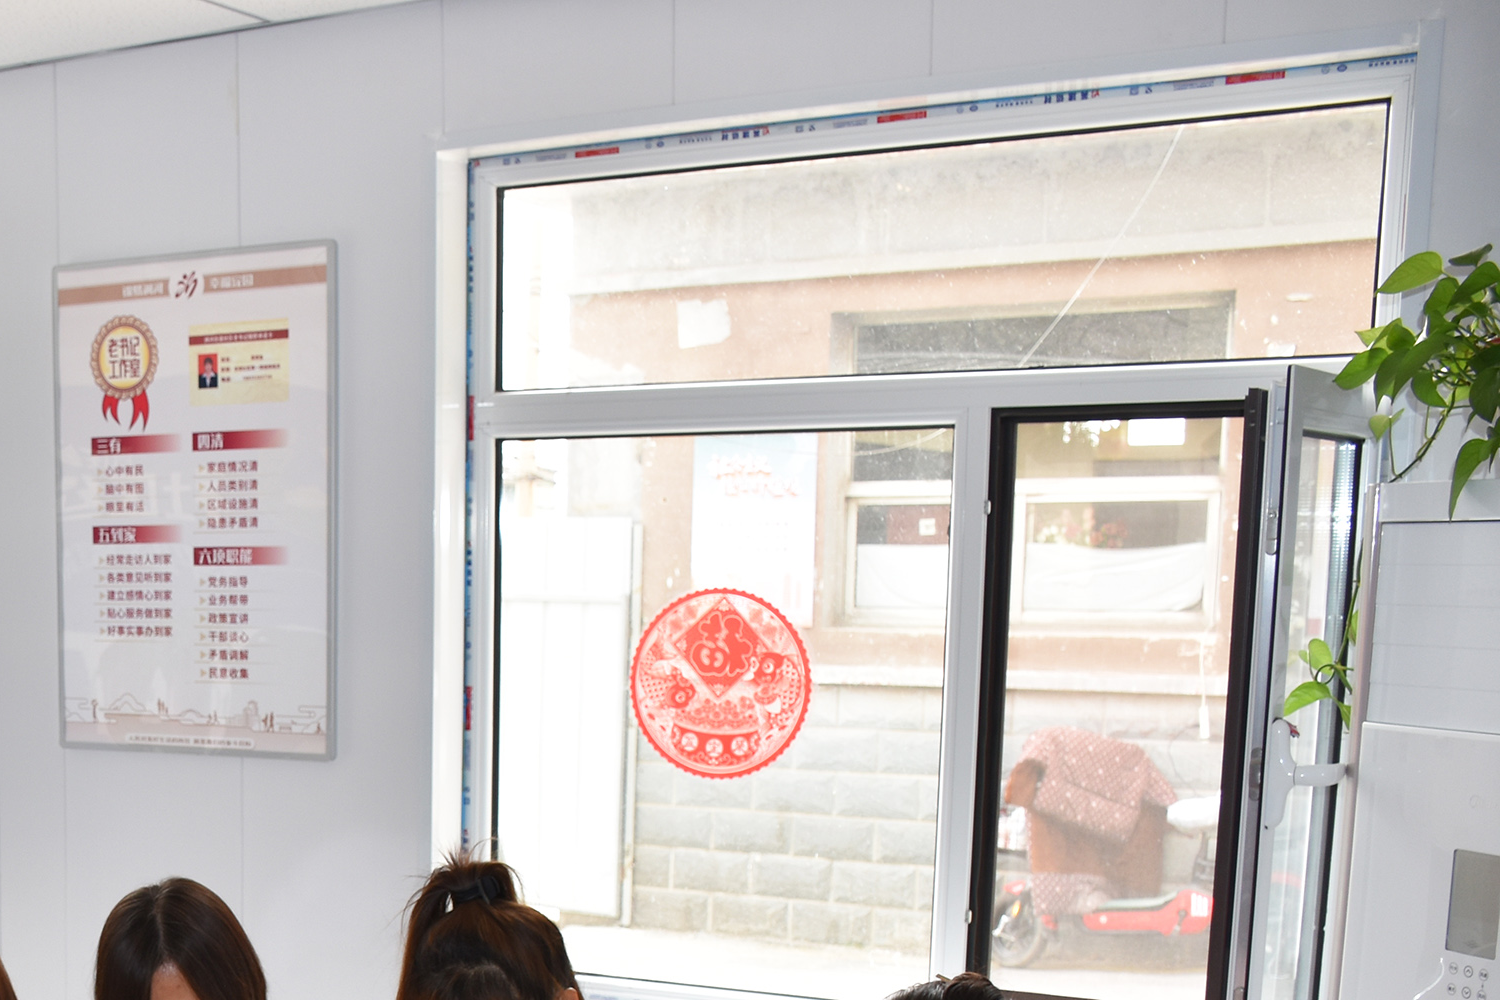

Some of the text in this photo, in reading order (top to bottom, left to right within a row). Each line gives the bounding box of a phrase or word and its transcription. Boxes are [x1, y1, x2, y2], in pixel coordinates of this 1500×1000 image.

[108, 336, 140, 358] 老书记
[108, 358, 141, 380] 工作室
